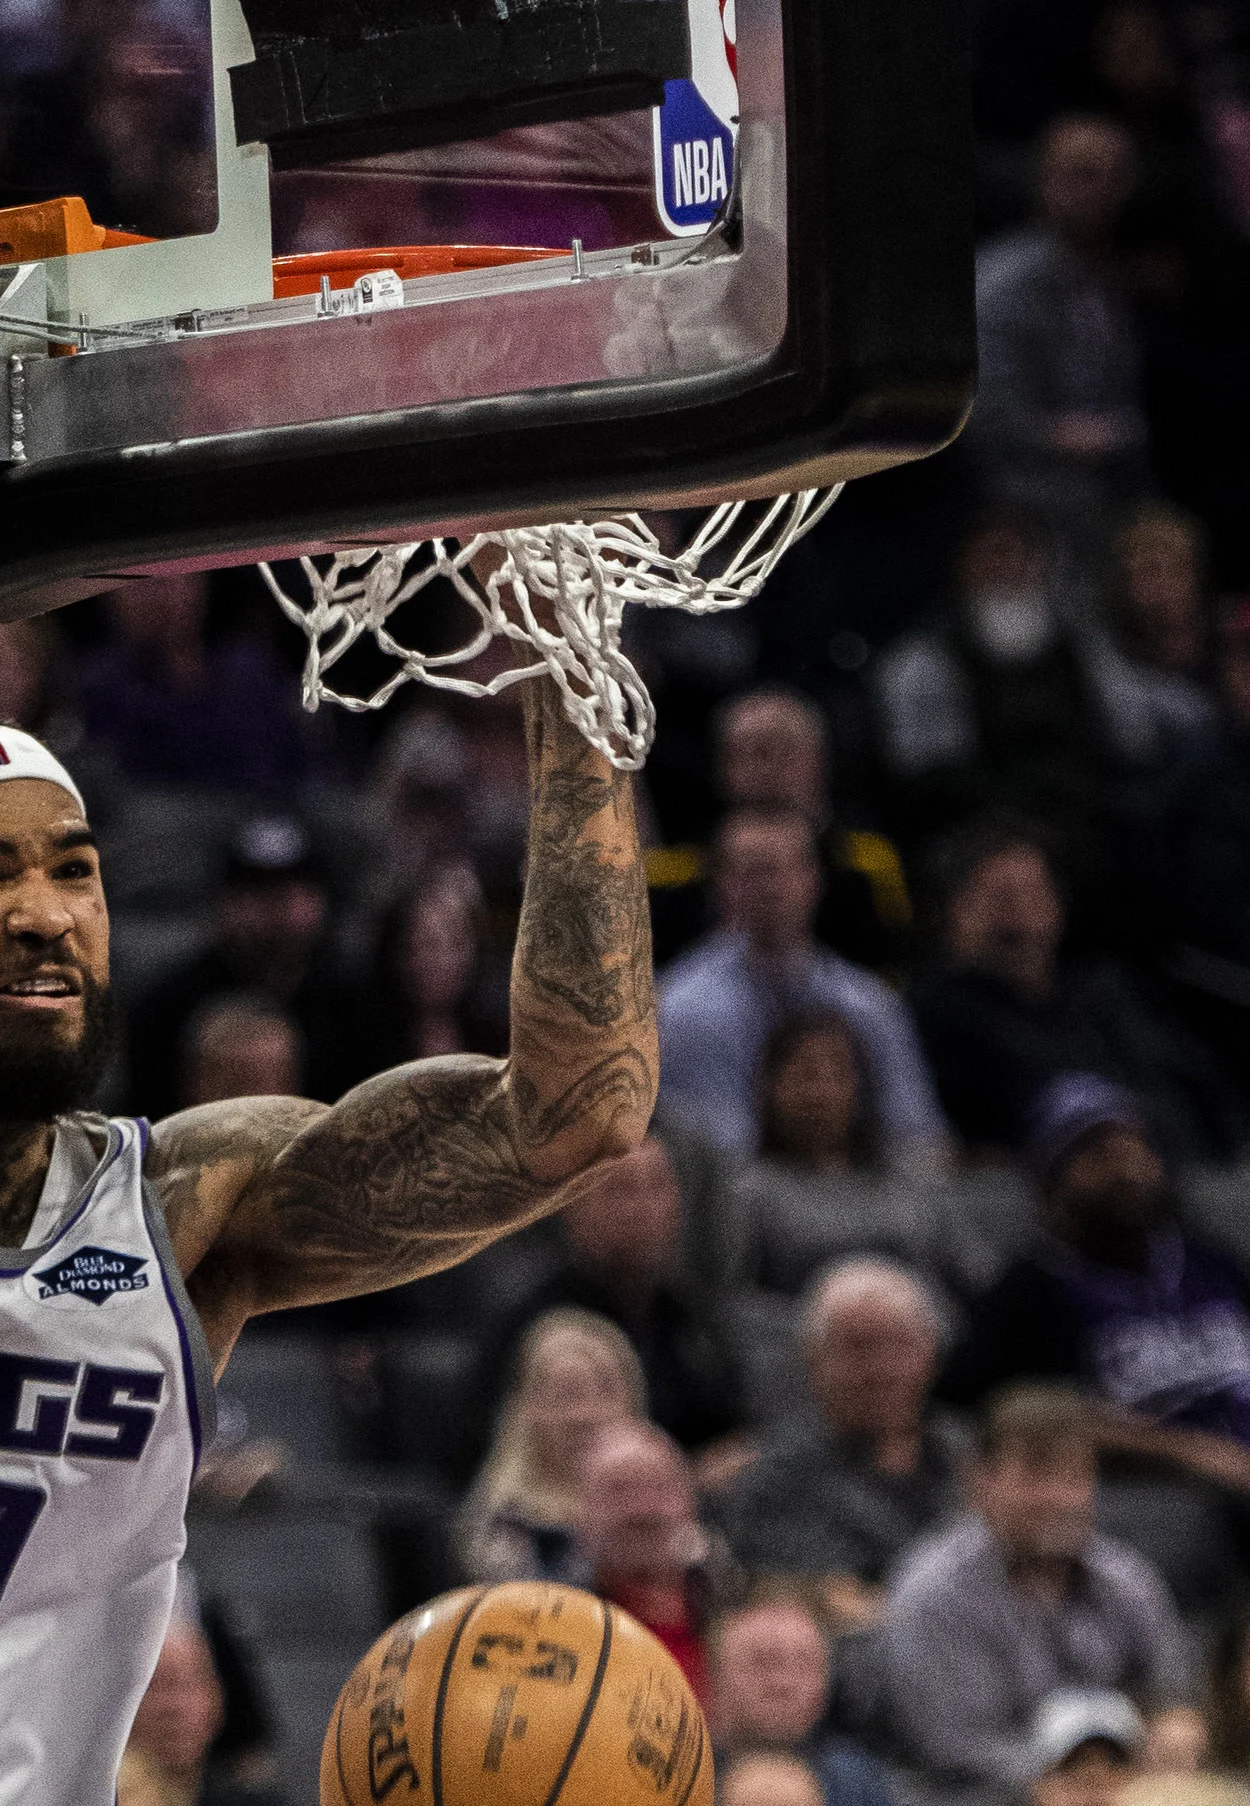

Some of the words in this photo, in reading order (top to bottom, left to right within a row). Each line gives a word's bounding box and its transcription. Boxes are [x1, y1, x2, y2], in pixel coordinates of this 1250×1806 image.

[673, 136, 728, 208] NBA
[58, 1261, 126, 1281] DIAMOND
[42, 1277, 146, 1298] ALMONDS
